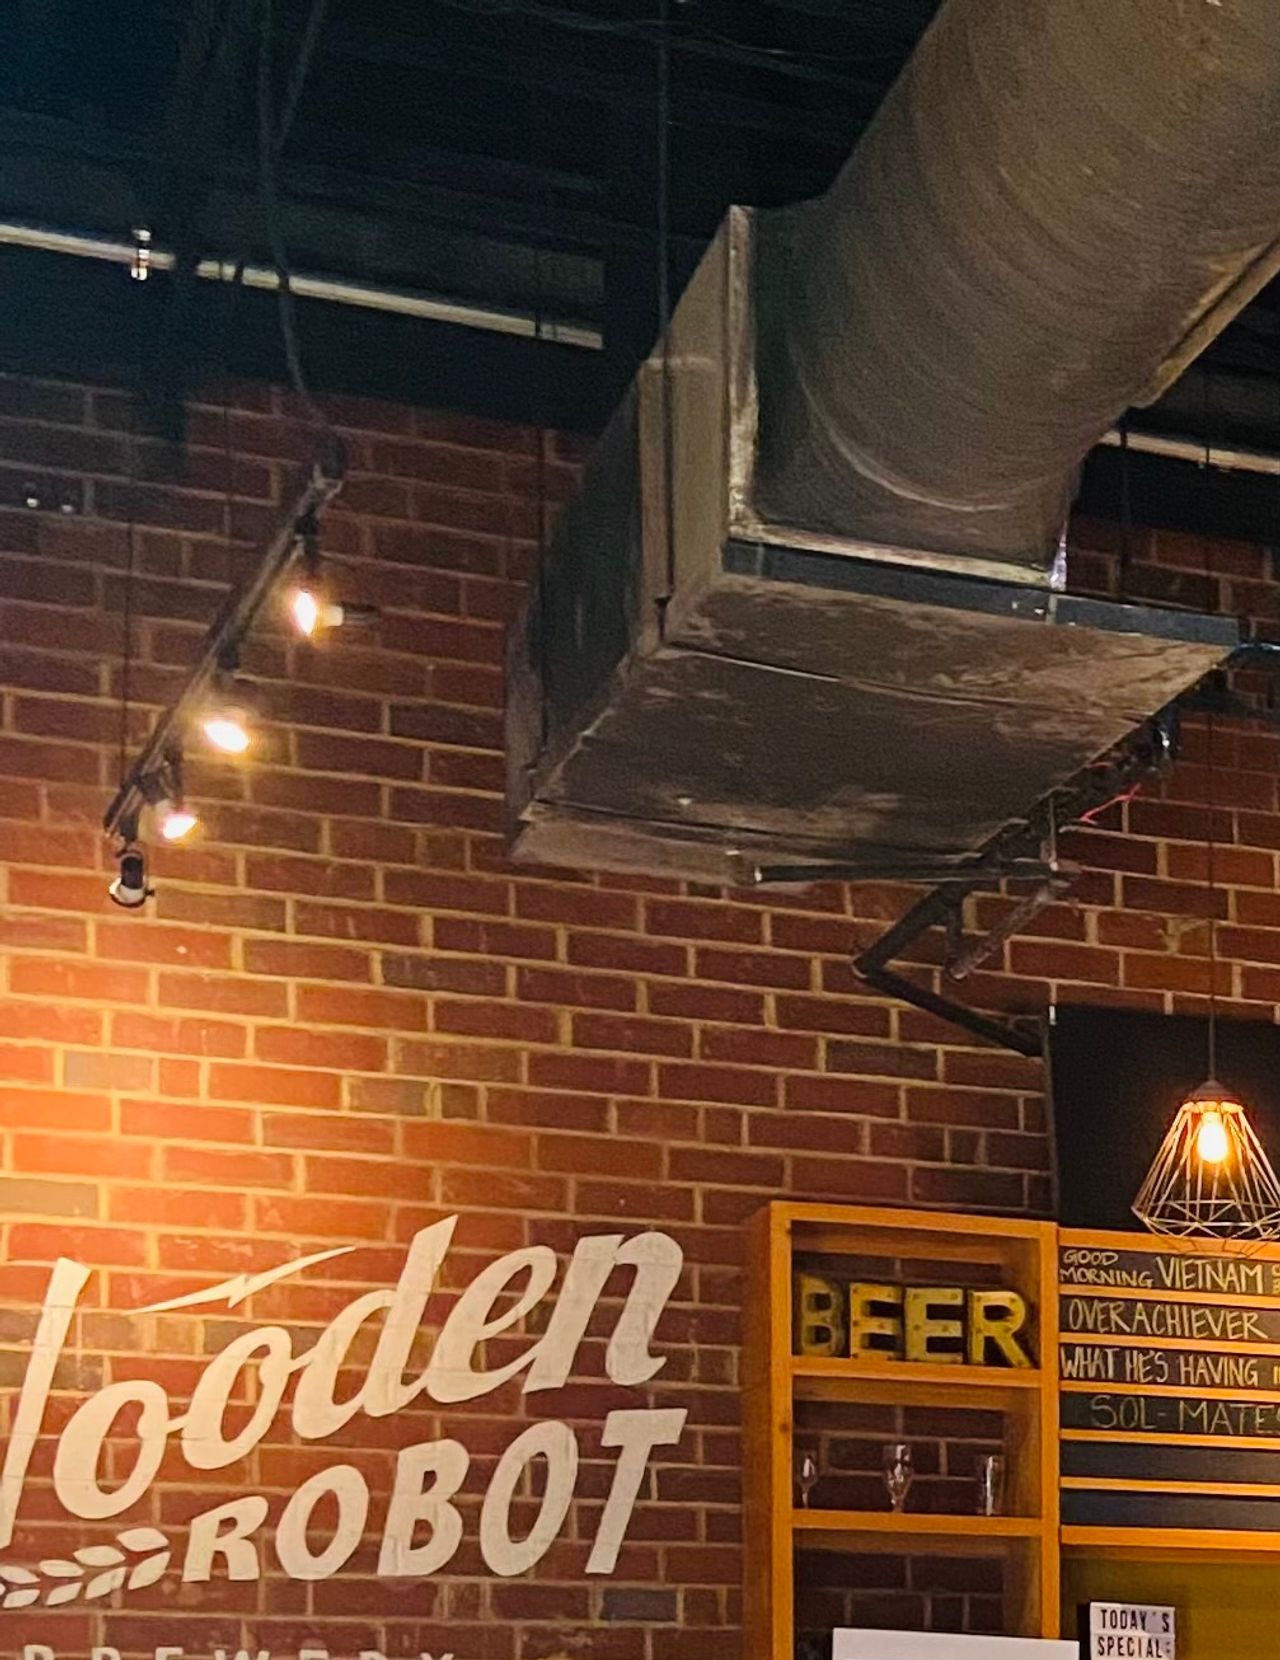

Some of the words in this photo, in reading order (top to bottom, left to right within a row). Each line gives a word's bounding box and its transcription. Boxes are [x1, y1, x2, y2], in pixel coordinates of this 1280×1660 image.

[1059, 1266, 1154, 1289] MORNING
[1156, 1256, 1264, 1294] VIETNAM
[1063, 1249, 1119, 1266] GOOD
[798, 1272, 1034, 1369] BEER
[0, 1215, 683, 1549] ooden
[1060, 1346, 1121, 1379] WHAT
[1125, 1349, 1169, 1383] HE'S
[1179, 1354, 1259, 1387] HAVING
[181, 1407, 688, 1583] ROBOT
